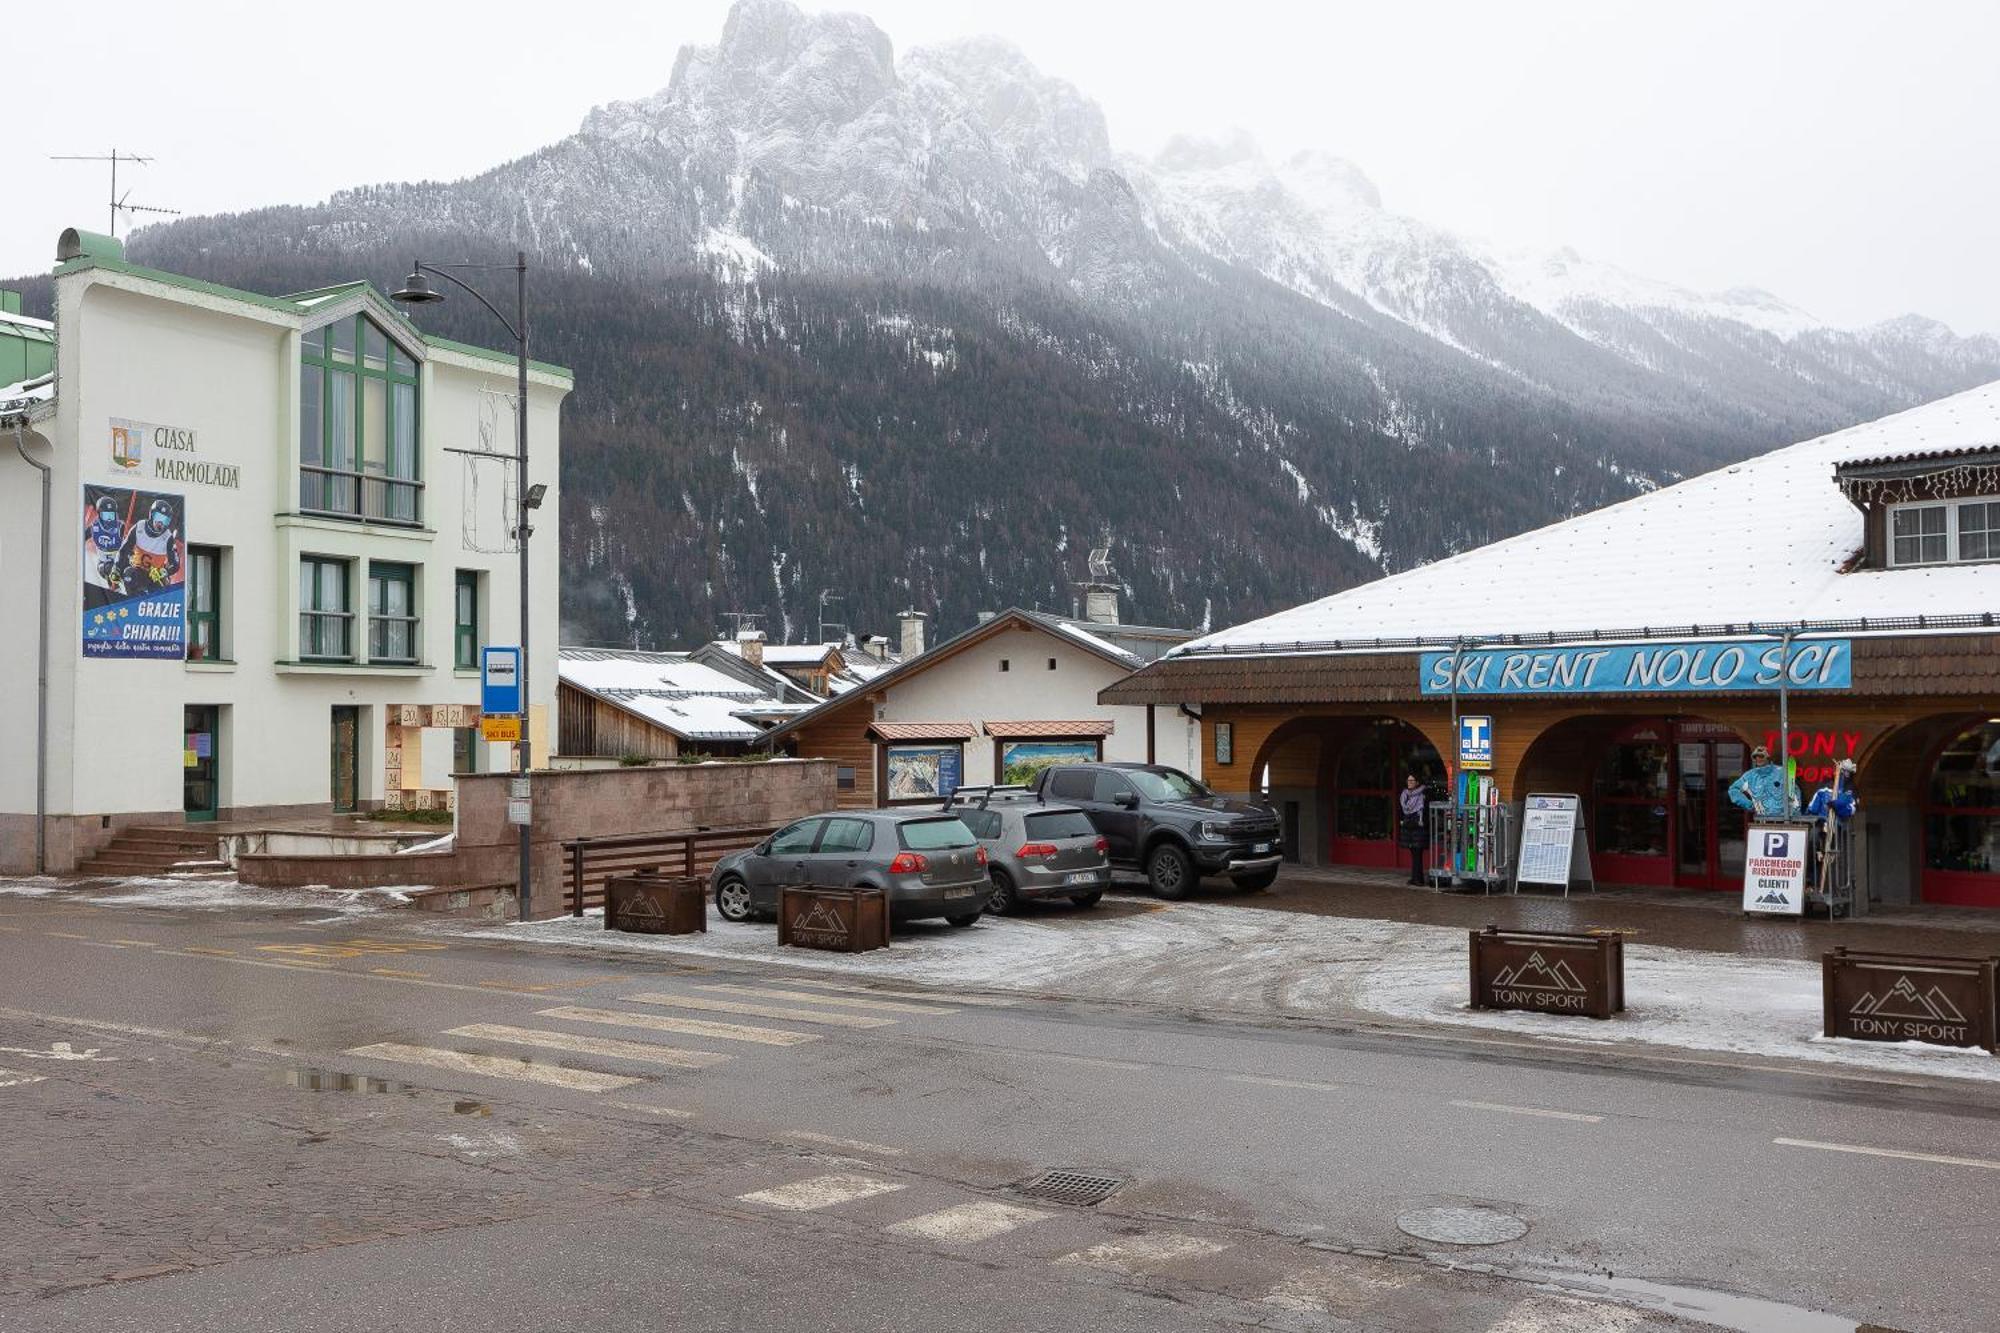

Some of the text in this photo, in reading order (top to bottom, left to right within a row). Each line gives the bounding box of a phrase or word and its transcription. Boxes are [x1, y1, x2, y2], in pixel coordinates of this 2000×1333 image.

[154, 427, 195, 453] CIASA
[155, 457, 239, 488] MARMOLADA
[138, 601, 181, 618] GRAZIE
[1429, 644, 1841, 690] SKI RENT NOLO SCI
[486, 730, 515, 738] SKI BUS
[1463, 719, 1488, 749] T
[1763, 730, 1862, 759] TONY
[1748, 858, 1802, 869] PARCHEGGIO
[1752, 867, 1797, 878] RISERVATO
[1758, 879, 1789, 889] CLIENTI
[1492, 988, 1588, 1009] TONY SPORT
[1850, 1017, 1968, 1041] TONY SPORT
